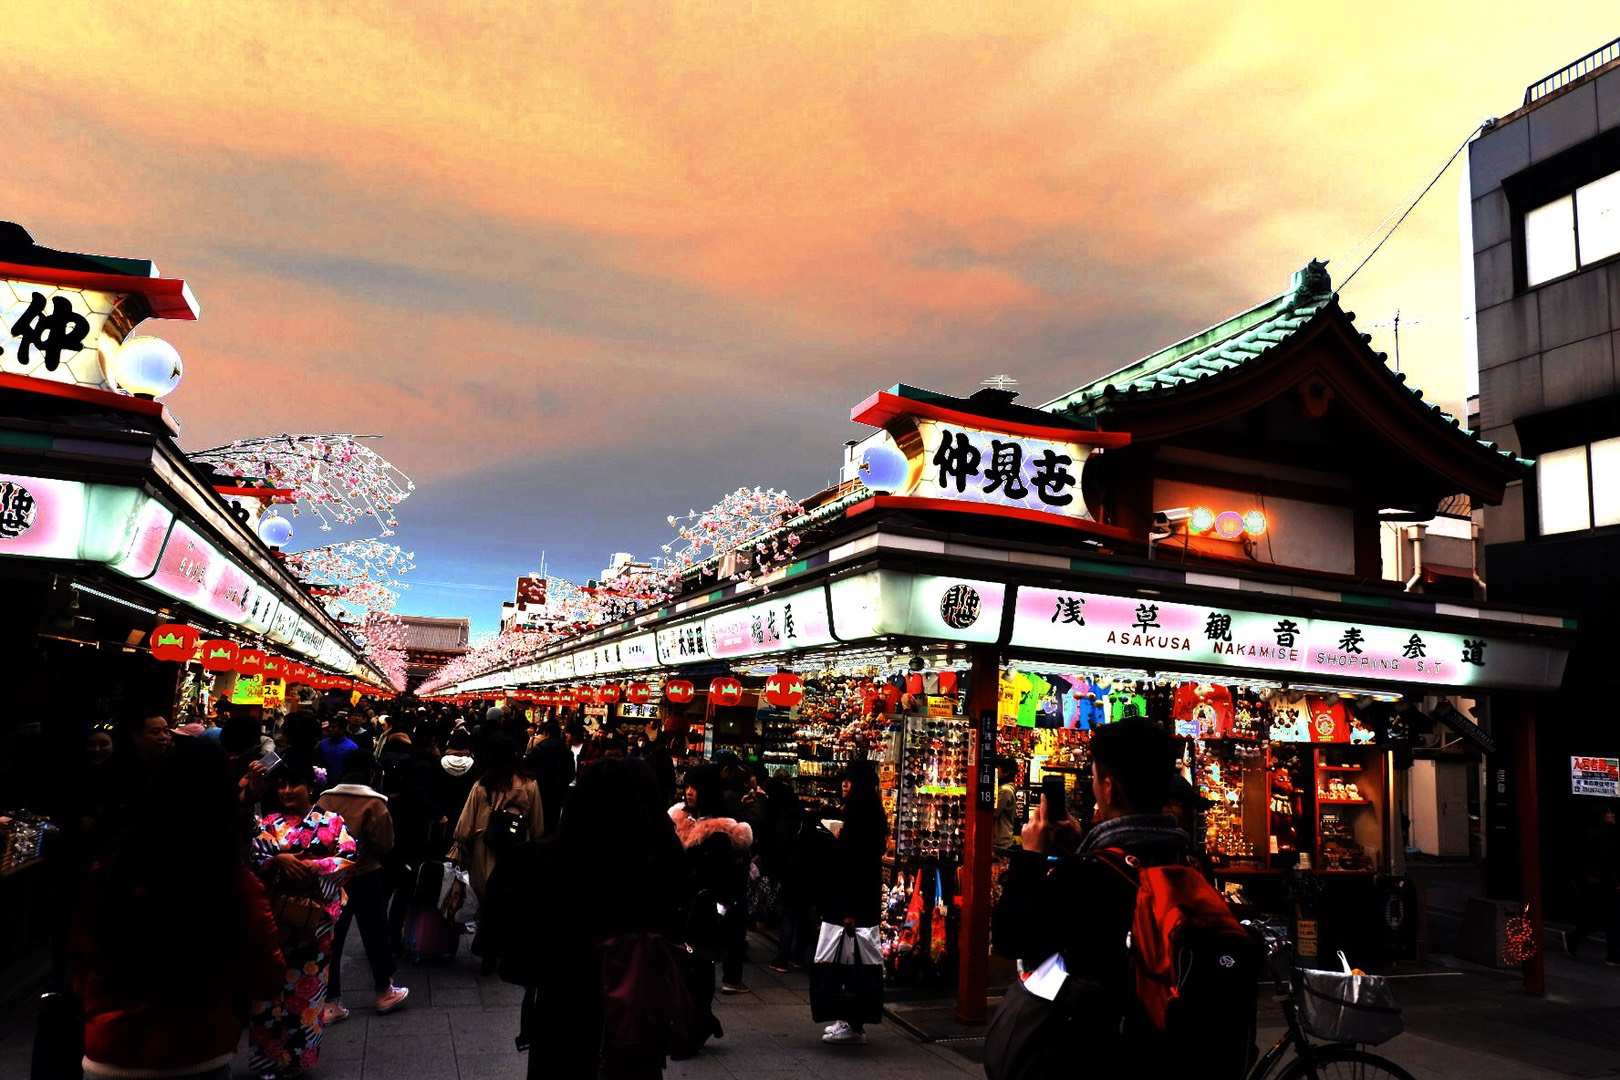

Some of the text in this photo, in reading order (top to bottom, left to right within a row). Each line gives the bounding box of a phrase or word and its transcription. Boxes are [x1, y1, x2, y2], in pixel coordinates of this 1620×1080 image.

[932, 429, 1077, 507] 仲見世
[1051, 596, 1488, 668] 浅草観音表参道
[1106, 630, 1191, 651] ASAKUSA
[1213, 641, 1298, 661] NAKAMISE
[1316, 652, 1400, 670] SHOPPING
[980, 791, 992, 802] 18
